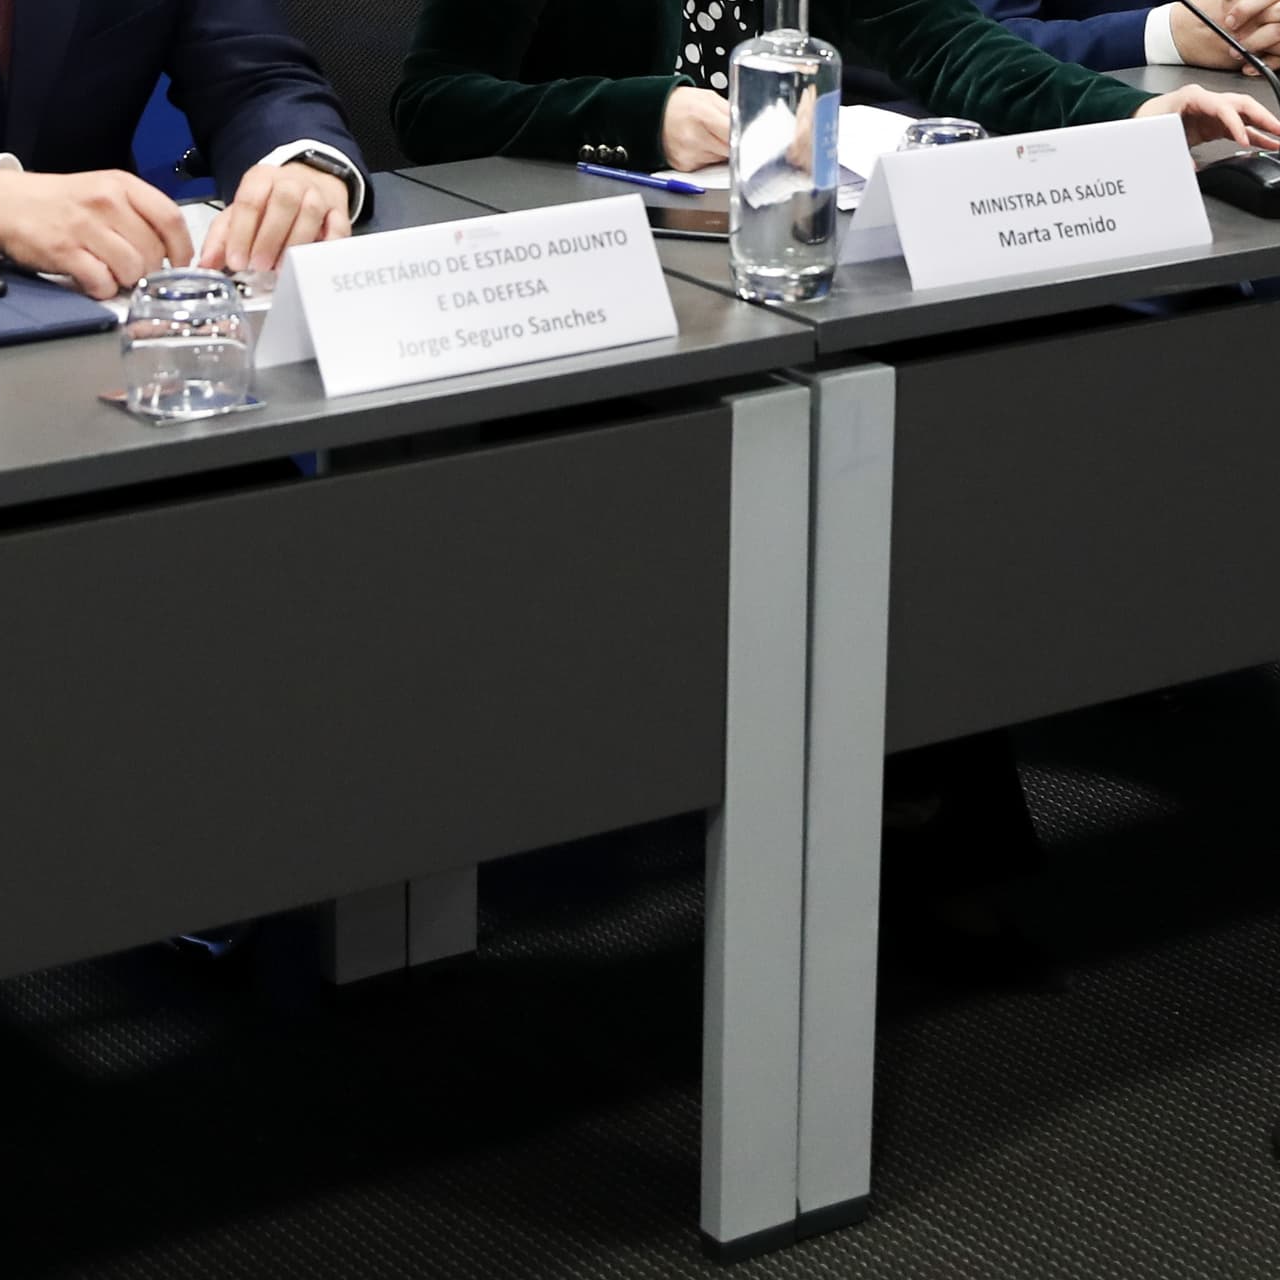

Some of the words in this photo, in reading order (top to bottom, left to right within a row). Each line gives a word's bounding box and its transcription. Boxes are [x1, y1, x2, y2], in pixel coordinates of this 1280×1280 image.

[970, 191, 1047, 217] MINISTRA
[1050, 188, 1072, 203] DA
[1076, 179, 1126, 201] SAÚDE
[999, 226, 1051, 248] Marta
[1054, 215, 1116, 240] Temido
[332, 260, 440, 292] SECRETÁRIO
[447, 254, 469, 273] DE
[475, 243, 541, 269] ESTADO
[548, 229, 627, 257] ADJUNTO
[438, 294, 448, 311] E
[454, 289, 480, 309] DA
[485, 279, 549, 303] DEFESA
[398, 328, 450, 359] Jorge
[455, 318, 523, 348] Seguro
[529, 307, 606, 335] Sanches
